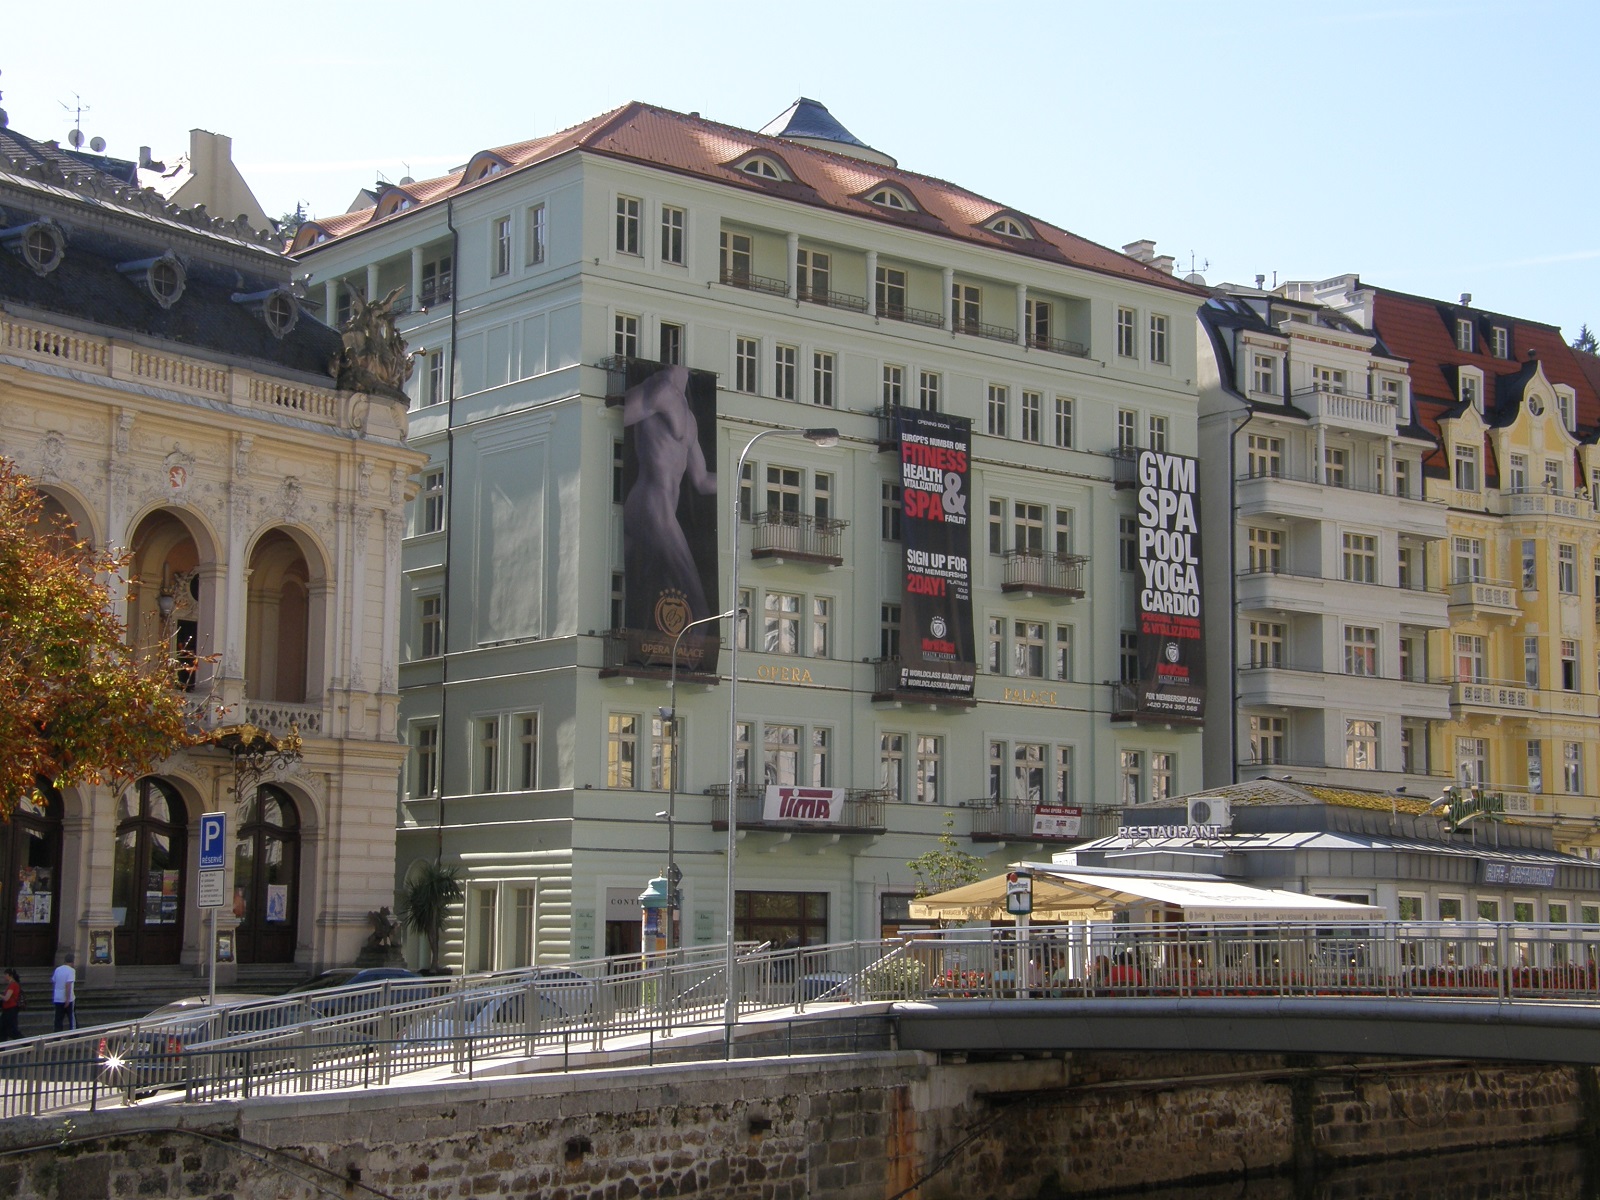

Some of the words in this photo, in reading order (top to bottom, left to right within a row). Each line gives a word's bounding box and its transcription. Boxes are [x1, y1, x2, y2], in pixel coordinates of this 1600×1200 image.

[901, 432, 929, 445] EUROPE'S
[930, 438, 954, 449] NUMBER
[955, 442, 967, 451] ONE
[902, 442, 967, 473] FITNESS
[903, 463, 943, 483] HEALTH
[1140, 451, 1196, 493] GYM
[903, 478, 943, 493] VITALIZATION
[942, 472, 967, 515] &
[904, 488, 944, 522] SPA
[1139, 486, 1197, 534] SPA
[945, 514, 967, 525] FACILITY
[1139, 527, 1198, 565] POOL
[907, 549, 929, 568] SIGN
[931, 553, 946, 569] UP
[947, 555, 967, 572] FOR
[907, 565, 924, 574] YOUR
[925, 568, 968, 579] MEMBERSHIP
[1139, 559, 1200, 595] YOGA
[907, 573, 946, 597] 2DAY!
[1141, 589, 1200, 617] CARDIO
[1143, 622, 1151, 634] &
[1151, 623, 1200, 639] VITALIZATION
[642, 643, 670, 655] OPERA
[757, 664, 813, 683] OPERA
[909, 669, 941, 679] WORLDCLASS
[942, 672, 961, 681] KARLOVY
[1004, 687, 1057, 705] PALACE
[205, 821, 220, 851] P
[1117, 825, 1221, 839] RESTAURANT
[201, 855, 222, 864] RÉSERVÉ
[1509, 865, 1555, 886] RESTAURANT
